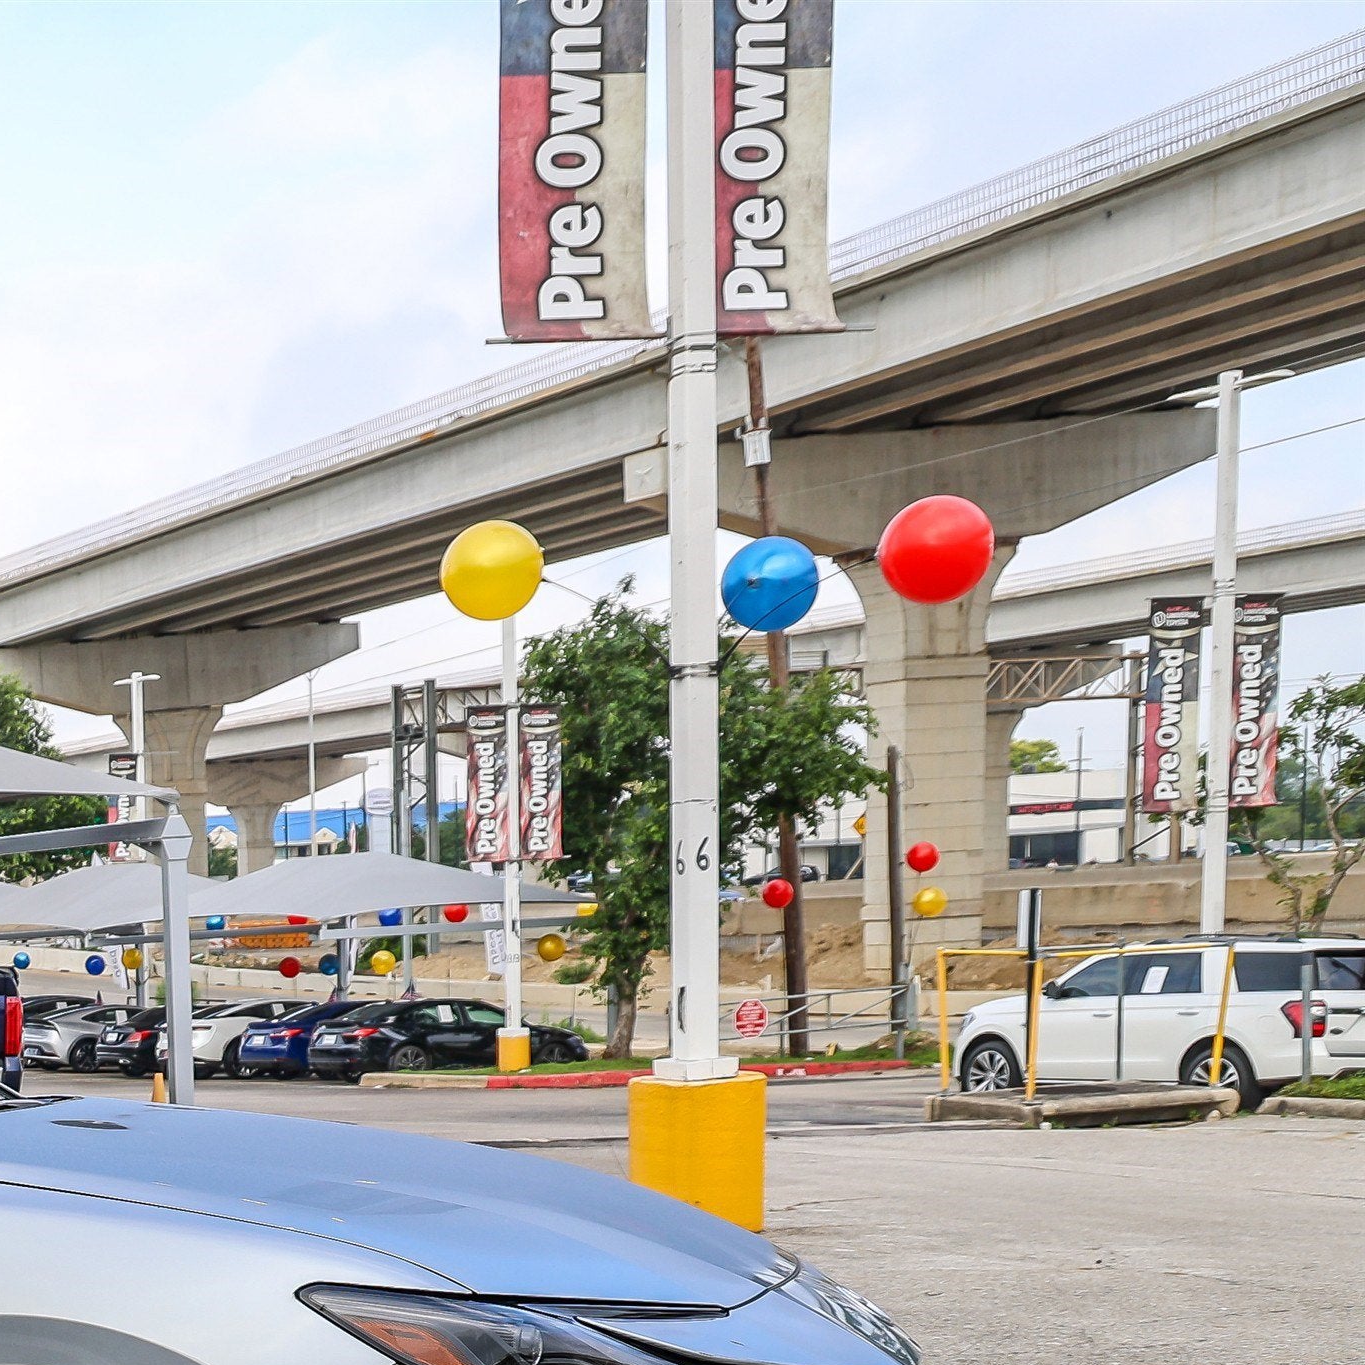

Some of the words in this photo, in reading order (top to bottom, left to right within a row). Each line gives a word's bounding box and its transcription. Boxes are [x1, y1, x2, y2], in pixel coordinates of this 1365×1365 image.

[537, 202, 605, 321] Pre
[722, 195, 788, 312] Pre
[1154, 648, 1186, 748] Owned
[1235, 644, 1263, 743] Owned
[474, 741, 496, 816] Owned
[527, 739, 548, 813] Owned
[1153, 752, 1181, 801] Pre
[1231, 748, 1259, 796] Pre
[476, 817, 497, 854] Pre
[529, 815, 549, 852] Pre
